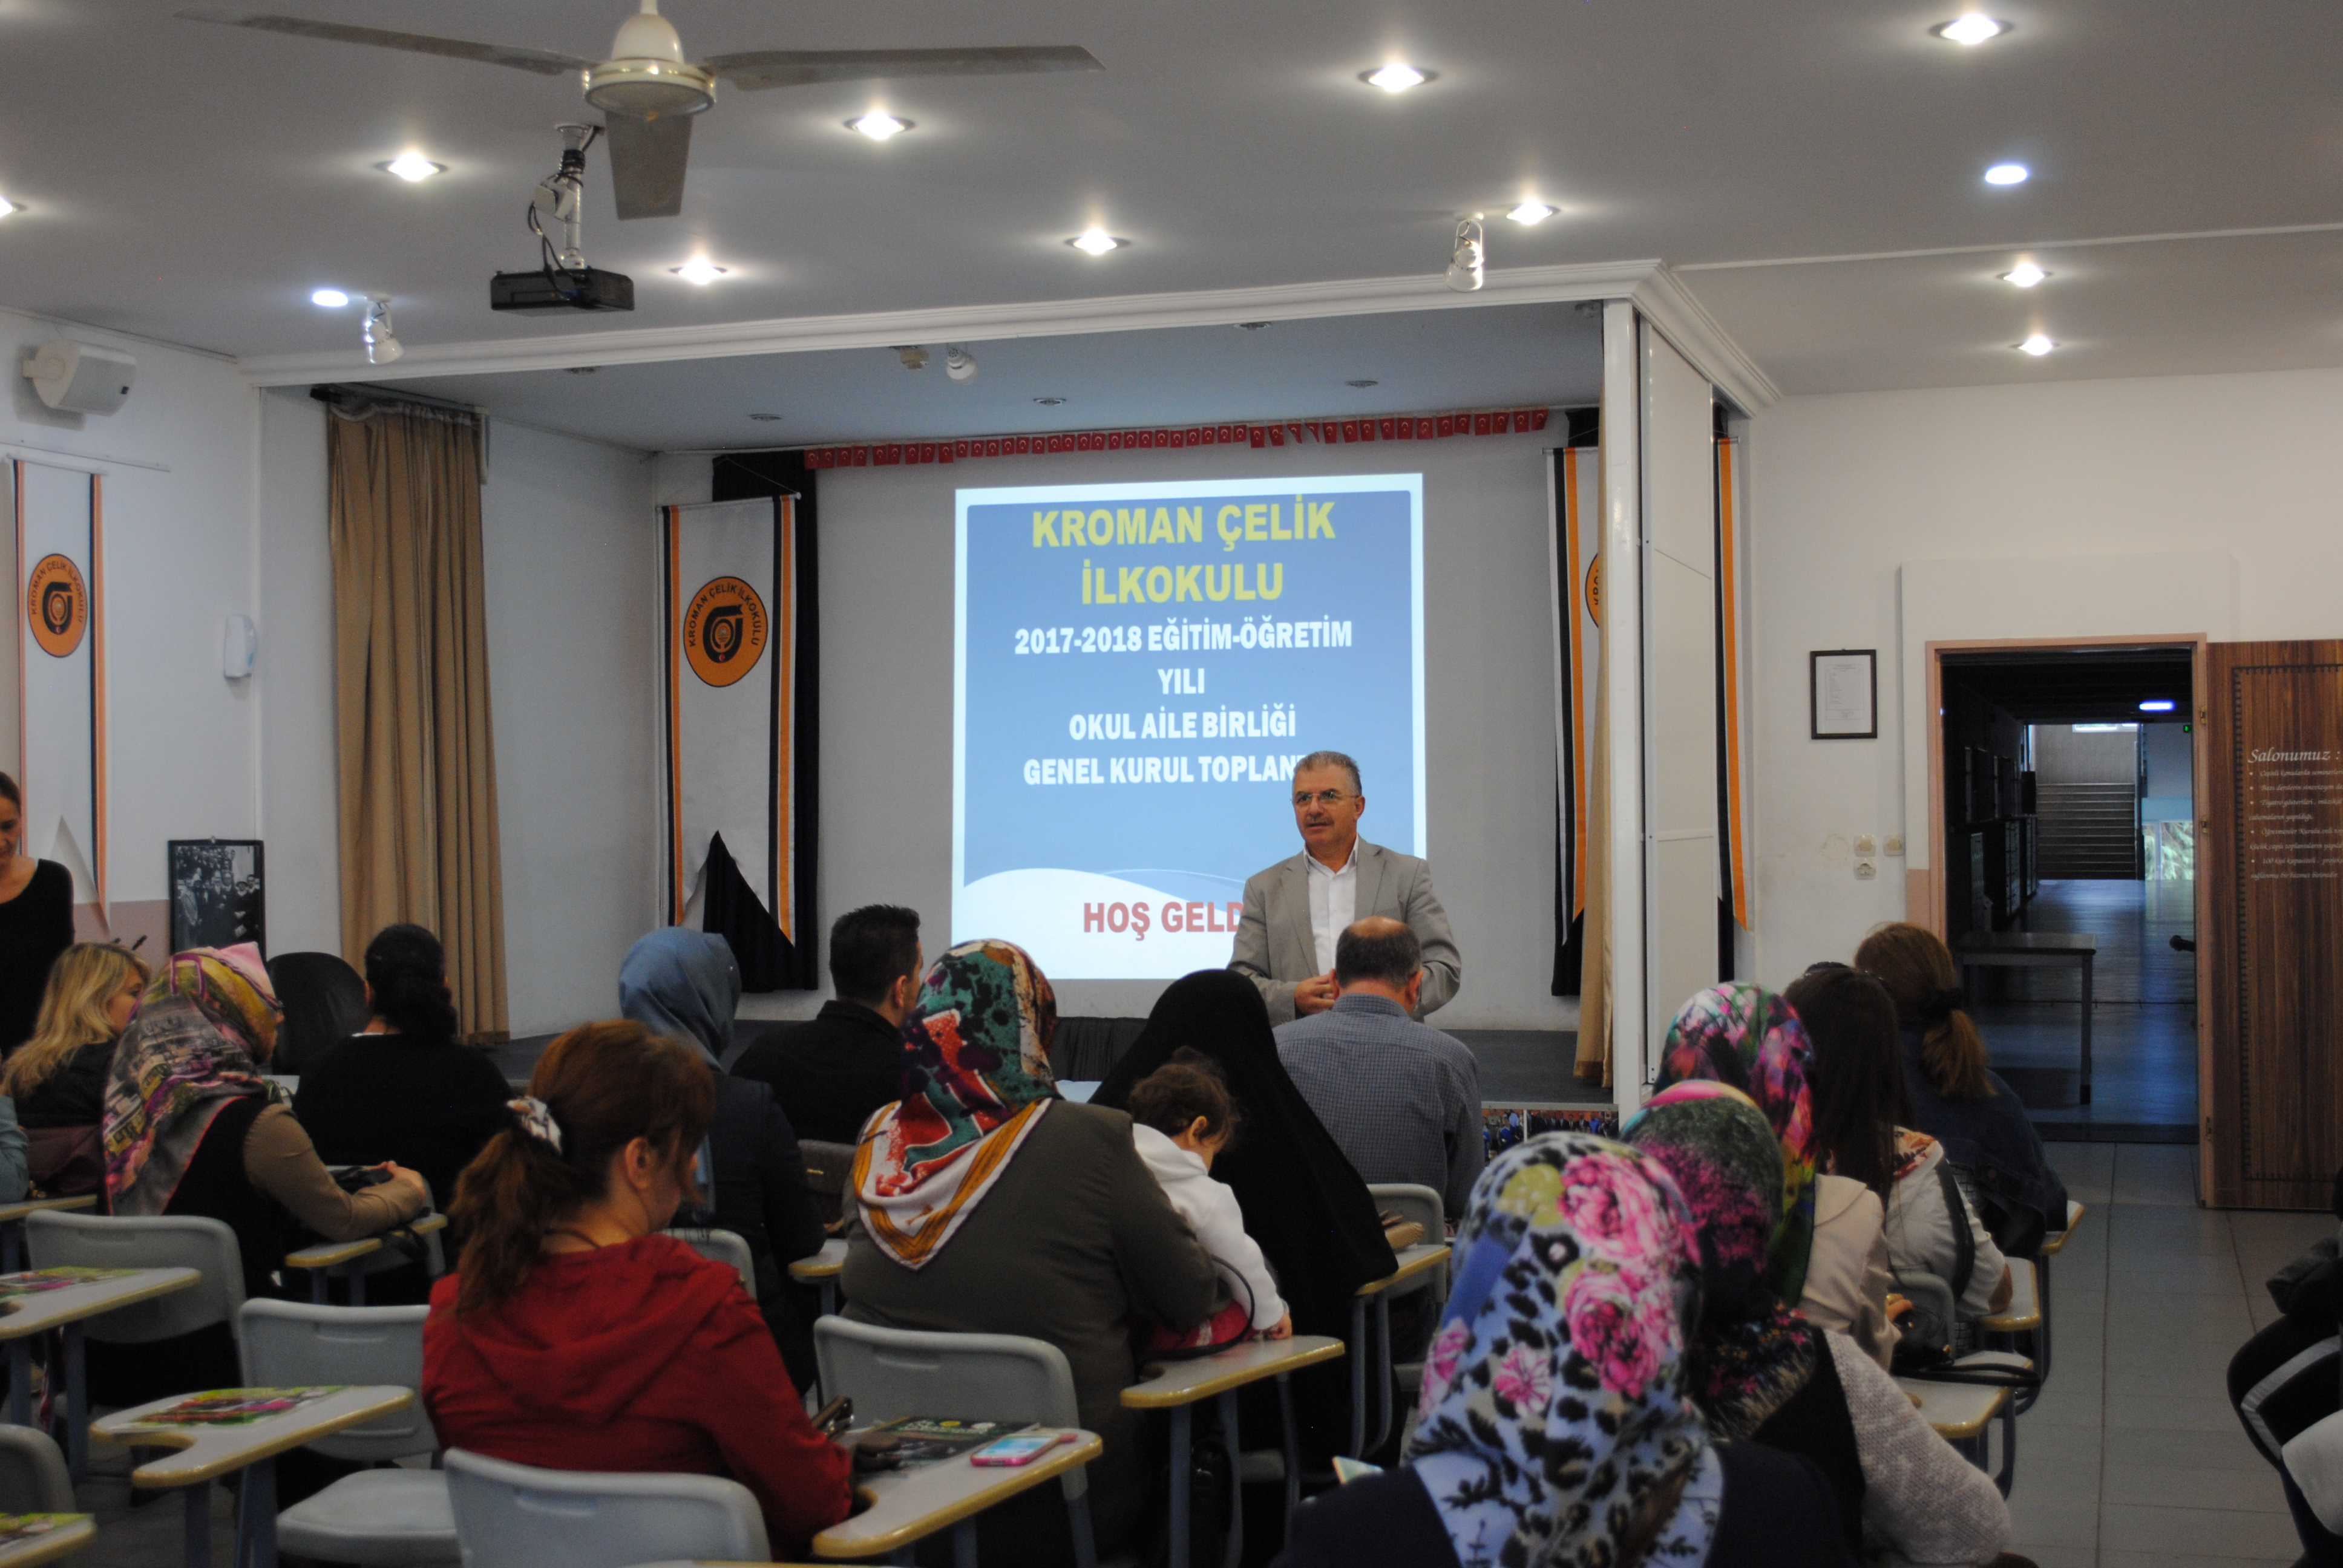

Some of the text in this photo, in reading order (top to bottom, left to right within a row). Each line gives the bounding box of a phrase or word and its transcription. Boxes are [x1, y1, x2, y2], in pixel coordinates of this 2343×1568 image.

[1032, 494, 1336, 552] KROMAN ÇELİK
[31, 569, 46, 615] KROMAN
[1082, 560, 1283, 604] İLKOKULU
[689, 582, 761, 647] KROMAN ÇELİK İLKOKULU
[1015, 615, 1352, 654] 2017-2018 EĞİTİM-ÖĞRETİM
[1158, 668, 1205, 694] YILI
[1069, 703, 1296, 740] OKUL AİLE BİRLİĞİ
[1024, 755, 1306, 785] GENEL KURUL TOPLAN
[2247, 746, 2330, 763] Salonumuz
[1083, 901, 1244, 940] HOŞ GELD
